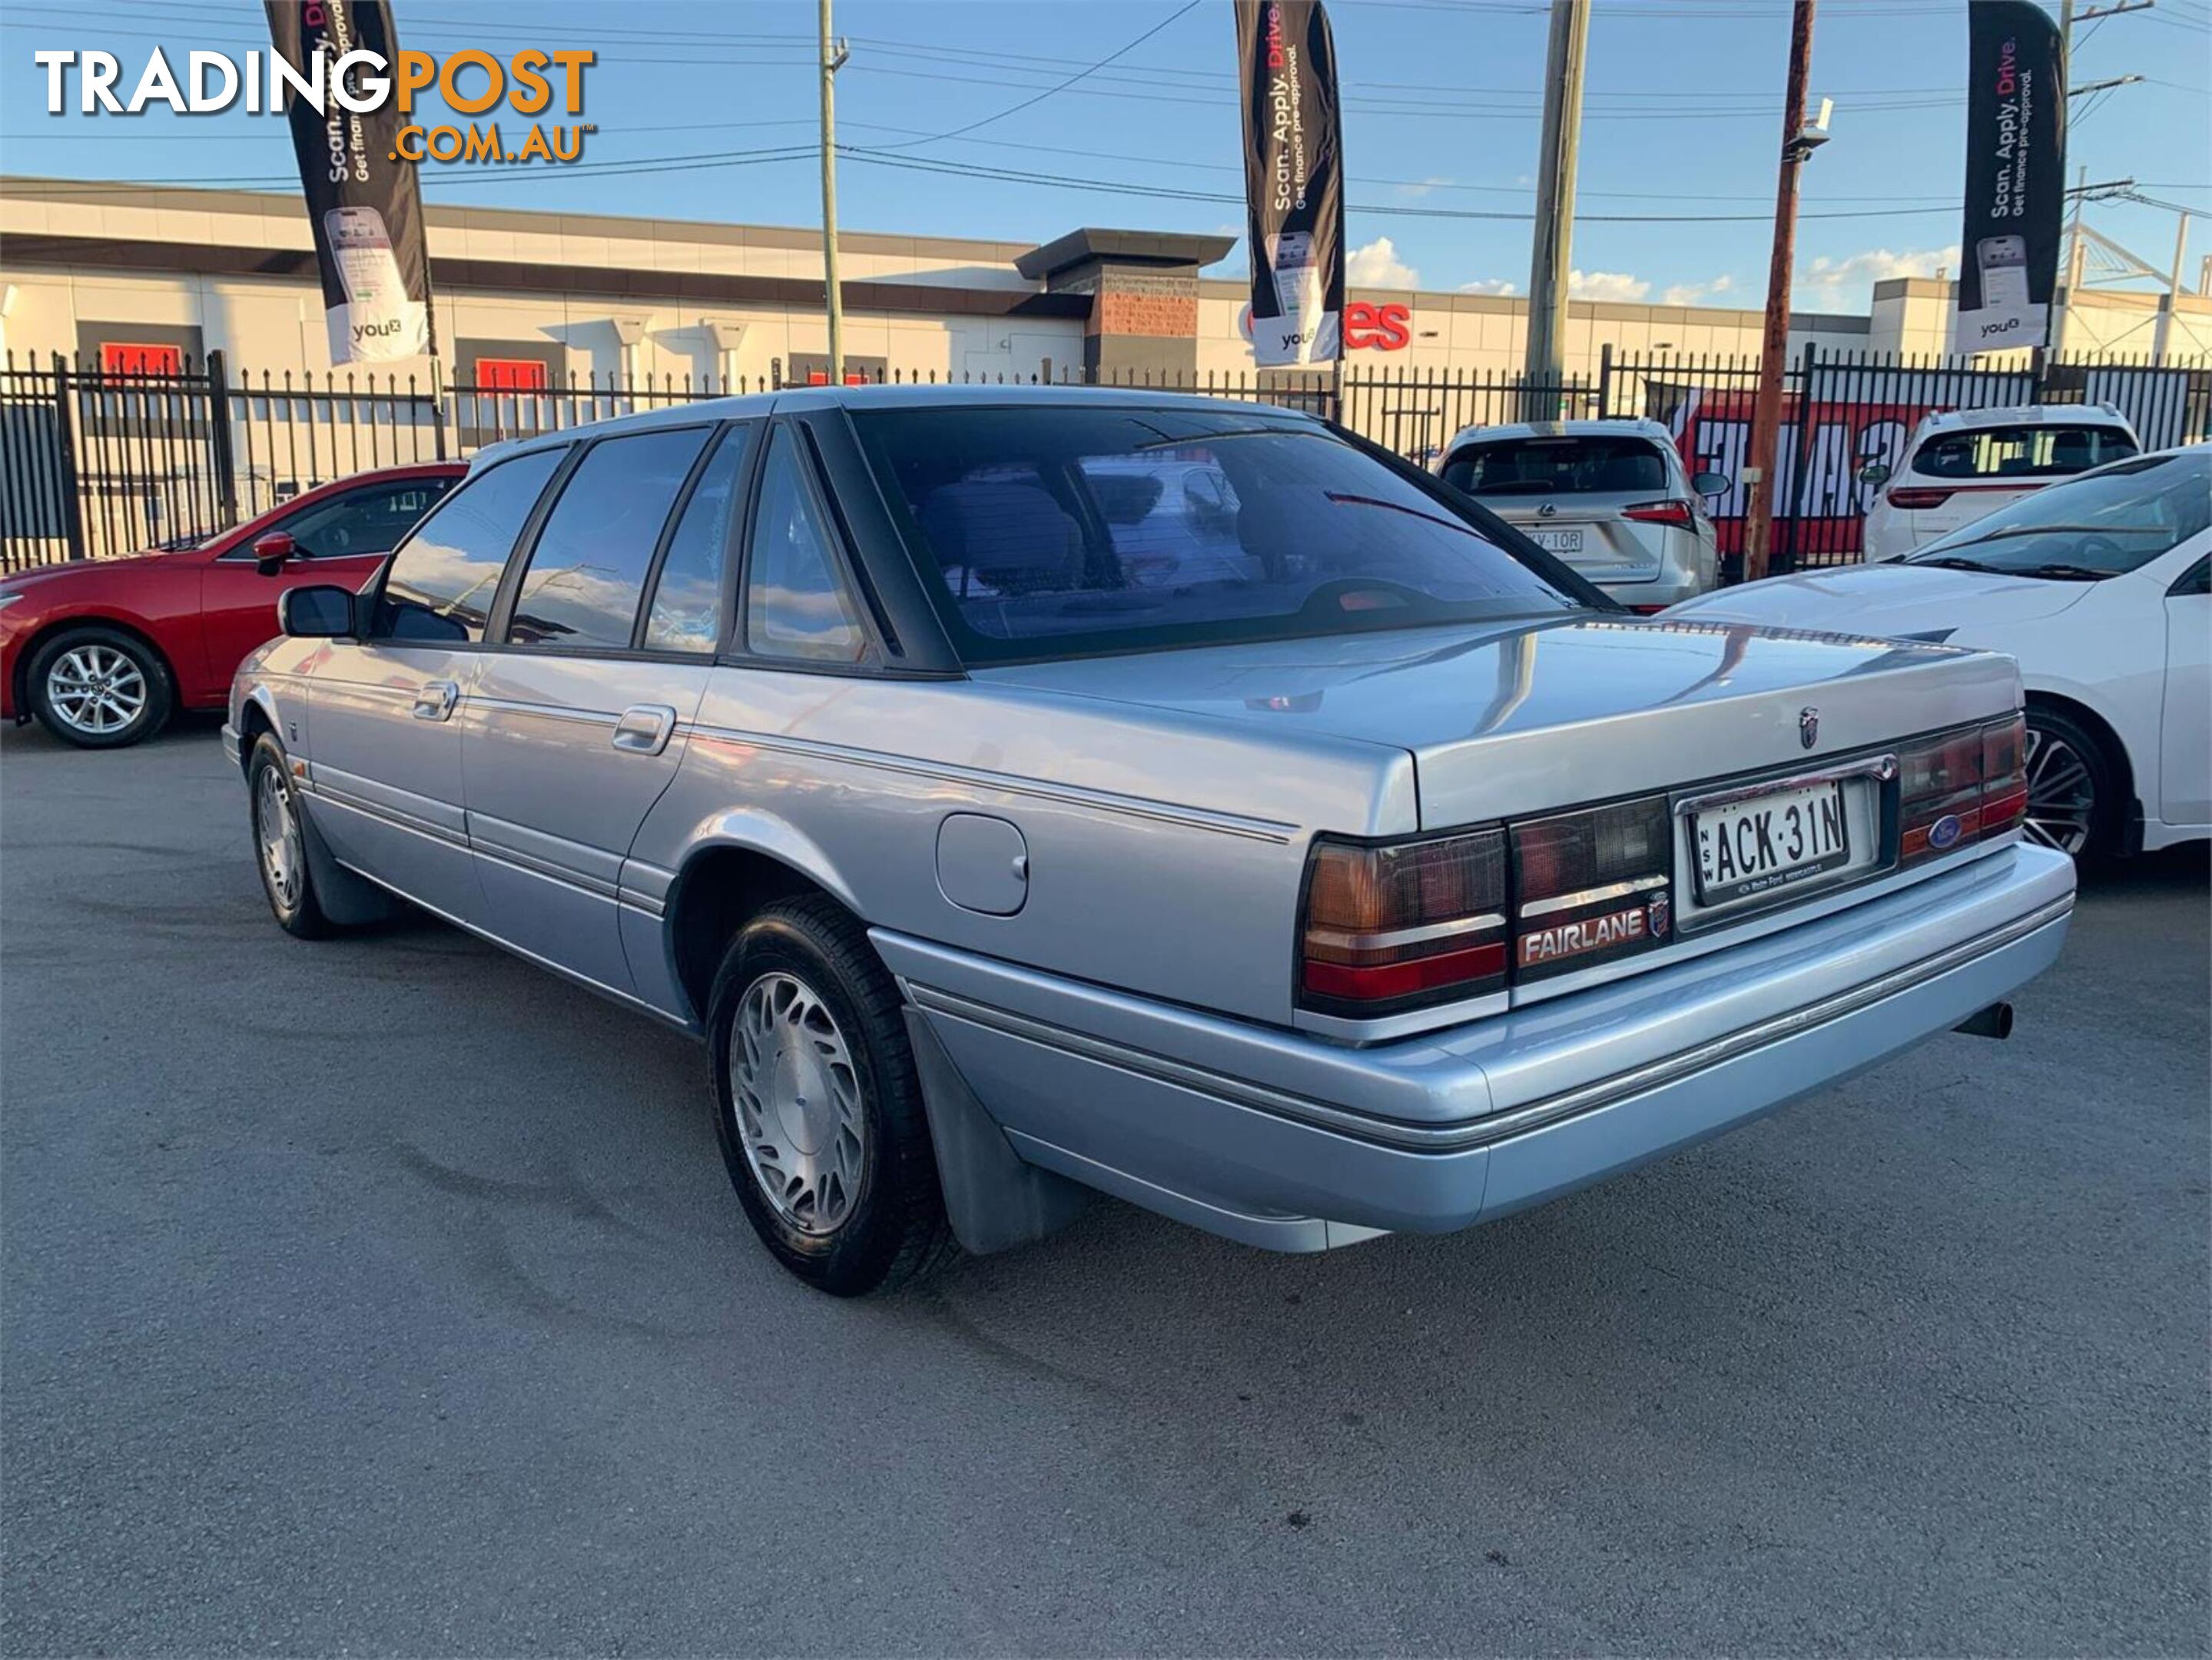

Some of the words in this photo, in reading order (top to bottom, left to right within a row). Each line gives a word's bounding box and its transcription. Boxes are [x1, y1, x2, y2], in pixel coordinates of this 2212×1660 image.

[1265, 3, 1284, 68] Drive.
[1997, 35, 2016, 95] Drive.
[1269, 73, 1292, 143] Apply.
[1286, 45, 1304, 131] pre-approval.
[2018, 69, 2033, 148] pre-approval.
[327, 115, 349, 183] Scan.
[1294, 134, 1305, 183] finance
[1995, 98, 2019, 159] Apply.
[355, 154, 370, 182] Get
[1275, 148, 1291, 211] Scan.
[1295, 185, 1306, 210] Get
[1991, 164, 2012, 217] Scan.
[2013, 149, 2028, 192] finance
[2013, 194, 2025, 216] Get
[1525, 910, 1643, 962] FAIRLANE
